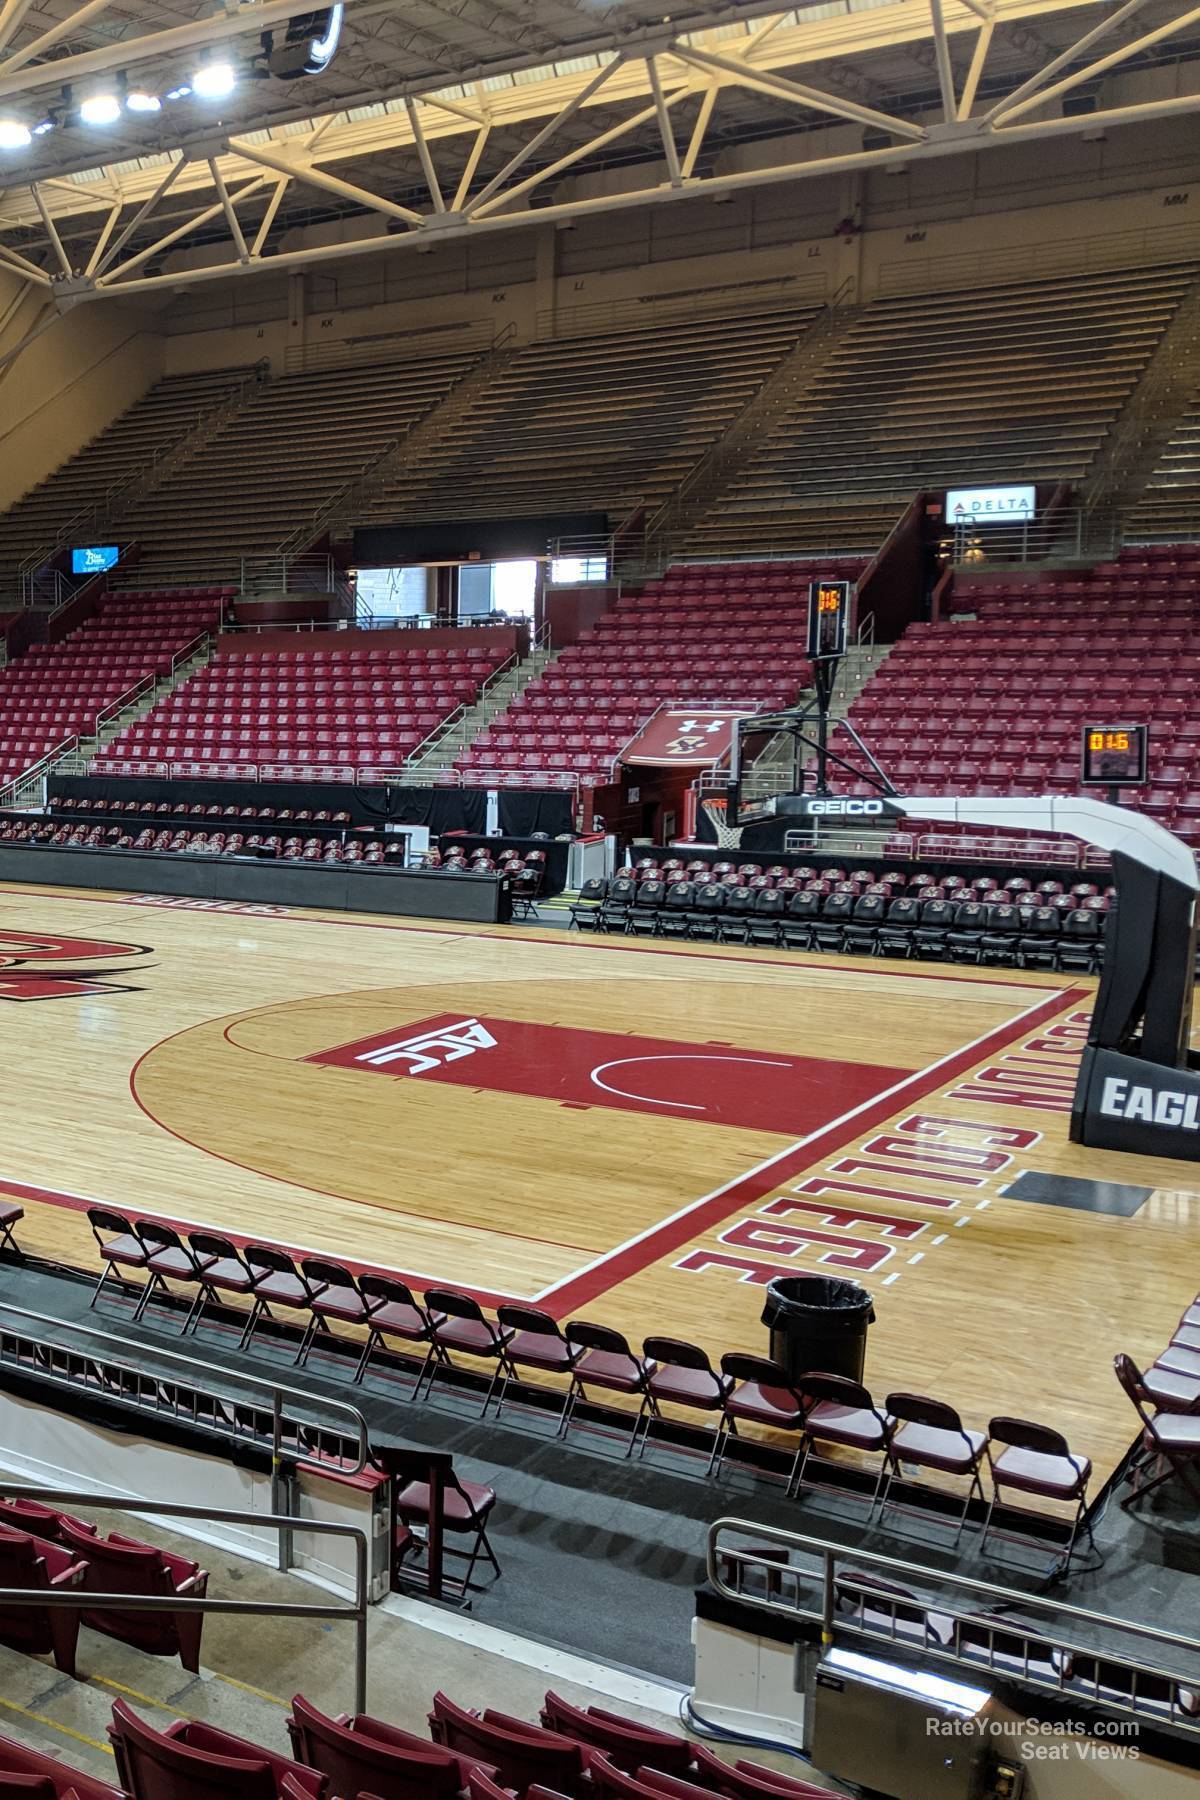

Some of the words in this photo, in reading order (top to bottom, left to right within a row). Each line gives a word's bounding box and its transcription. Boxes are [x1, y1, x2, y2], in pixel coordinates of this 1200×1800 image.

[971, 498, 1030, 511] DELTA
[807, 799, 883, 815] GEICO
[353, 1017, 499, 1075] ACC
[1100, 1076, 1200, 1130] EAGL
